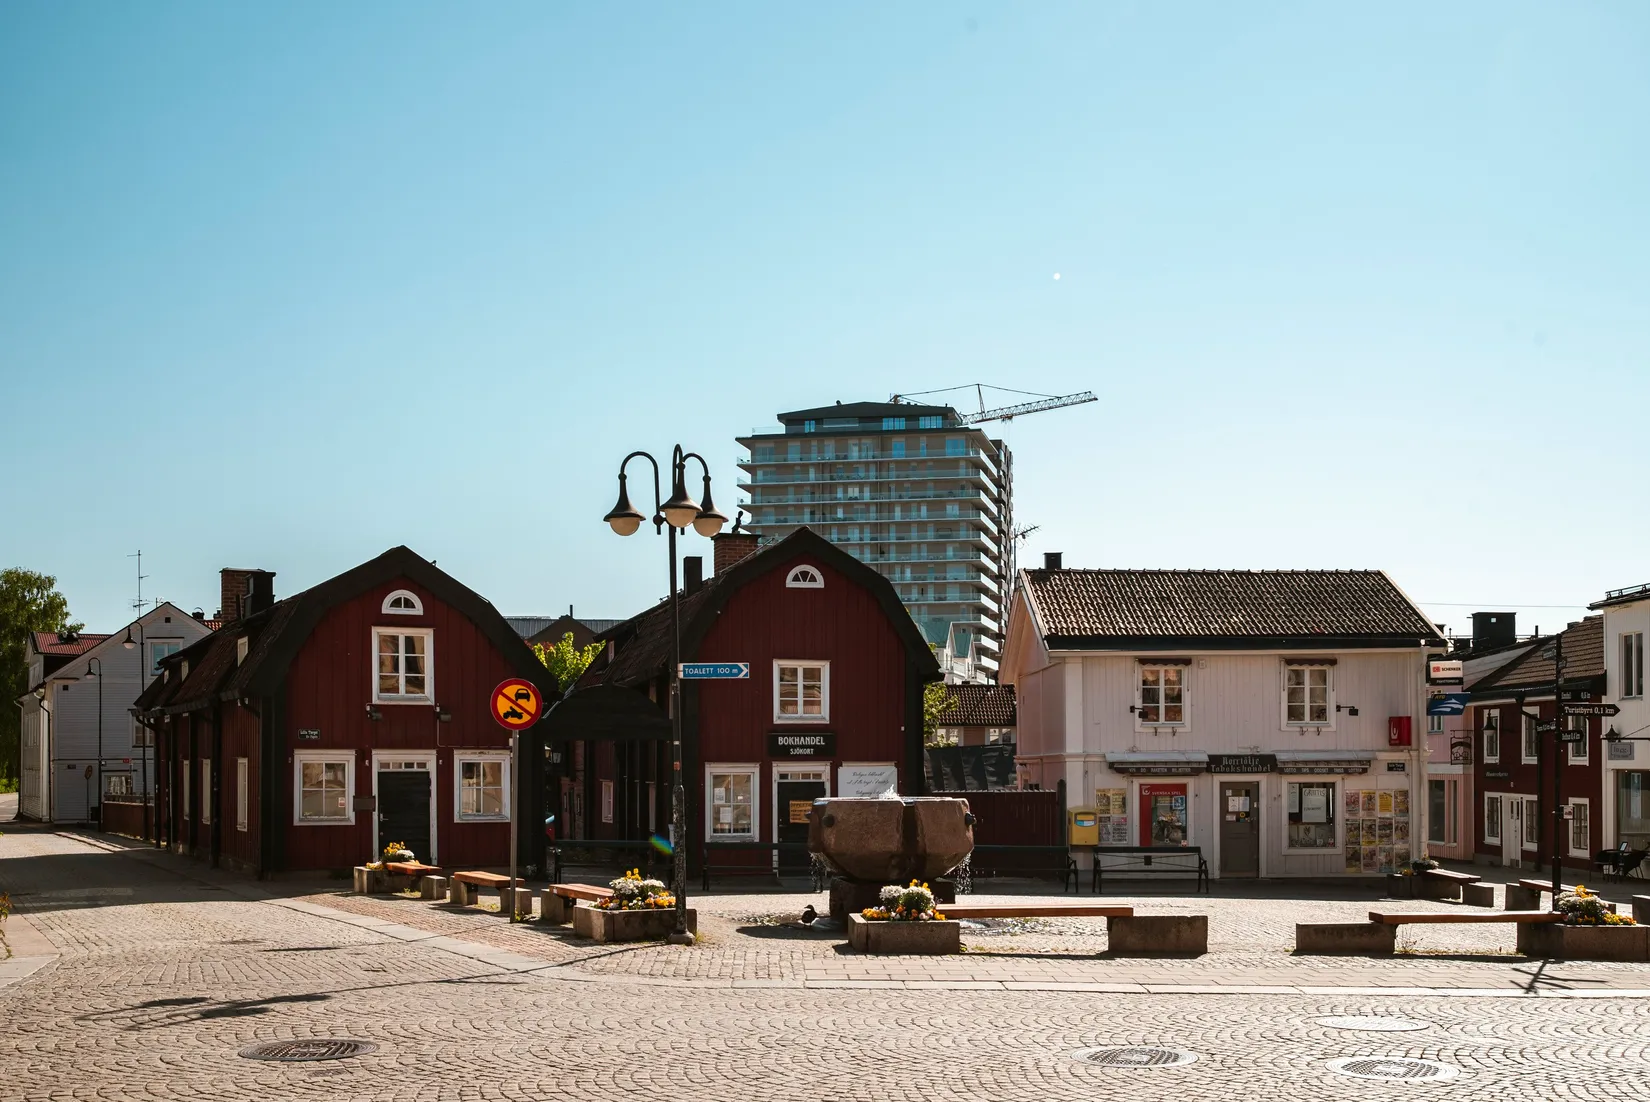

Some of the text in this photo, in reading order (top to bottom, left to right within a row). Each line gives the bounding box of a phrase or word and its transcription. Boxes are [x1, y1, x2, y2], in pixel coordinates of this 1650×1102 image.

[1605, 706, 1615, 714] km
[778, 736, 825, 745] BOKHANDEL
[1222, 756, 1260, 766] Norrtälje
[1211, 764, 1271, 773] Tabakshandel
